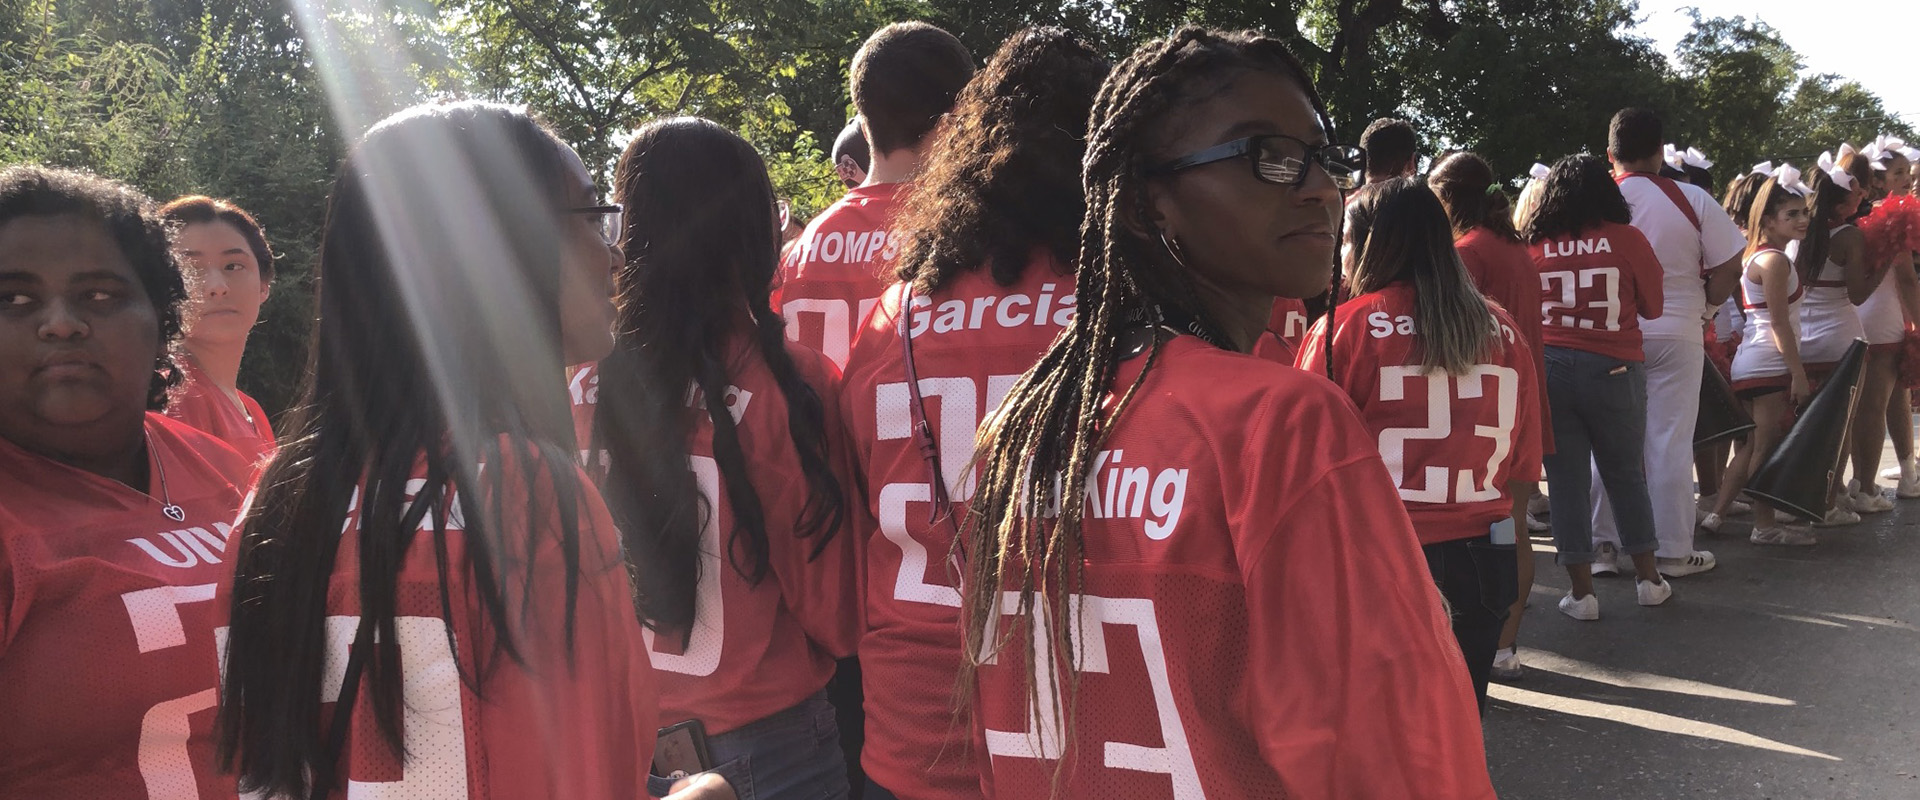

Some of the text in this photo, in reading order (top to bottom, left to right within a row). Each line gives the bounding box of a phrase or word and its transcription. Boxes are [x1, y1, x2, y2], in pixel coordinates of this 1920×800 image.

[1544, 238, 1612, 258] LUNA
[898, 283, 1078, 339] Garcia
[1539, 267, 1621, 331] 23
[1378, 364, 1519, 503] 23
